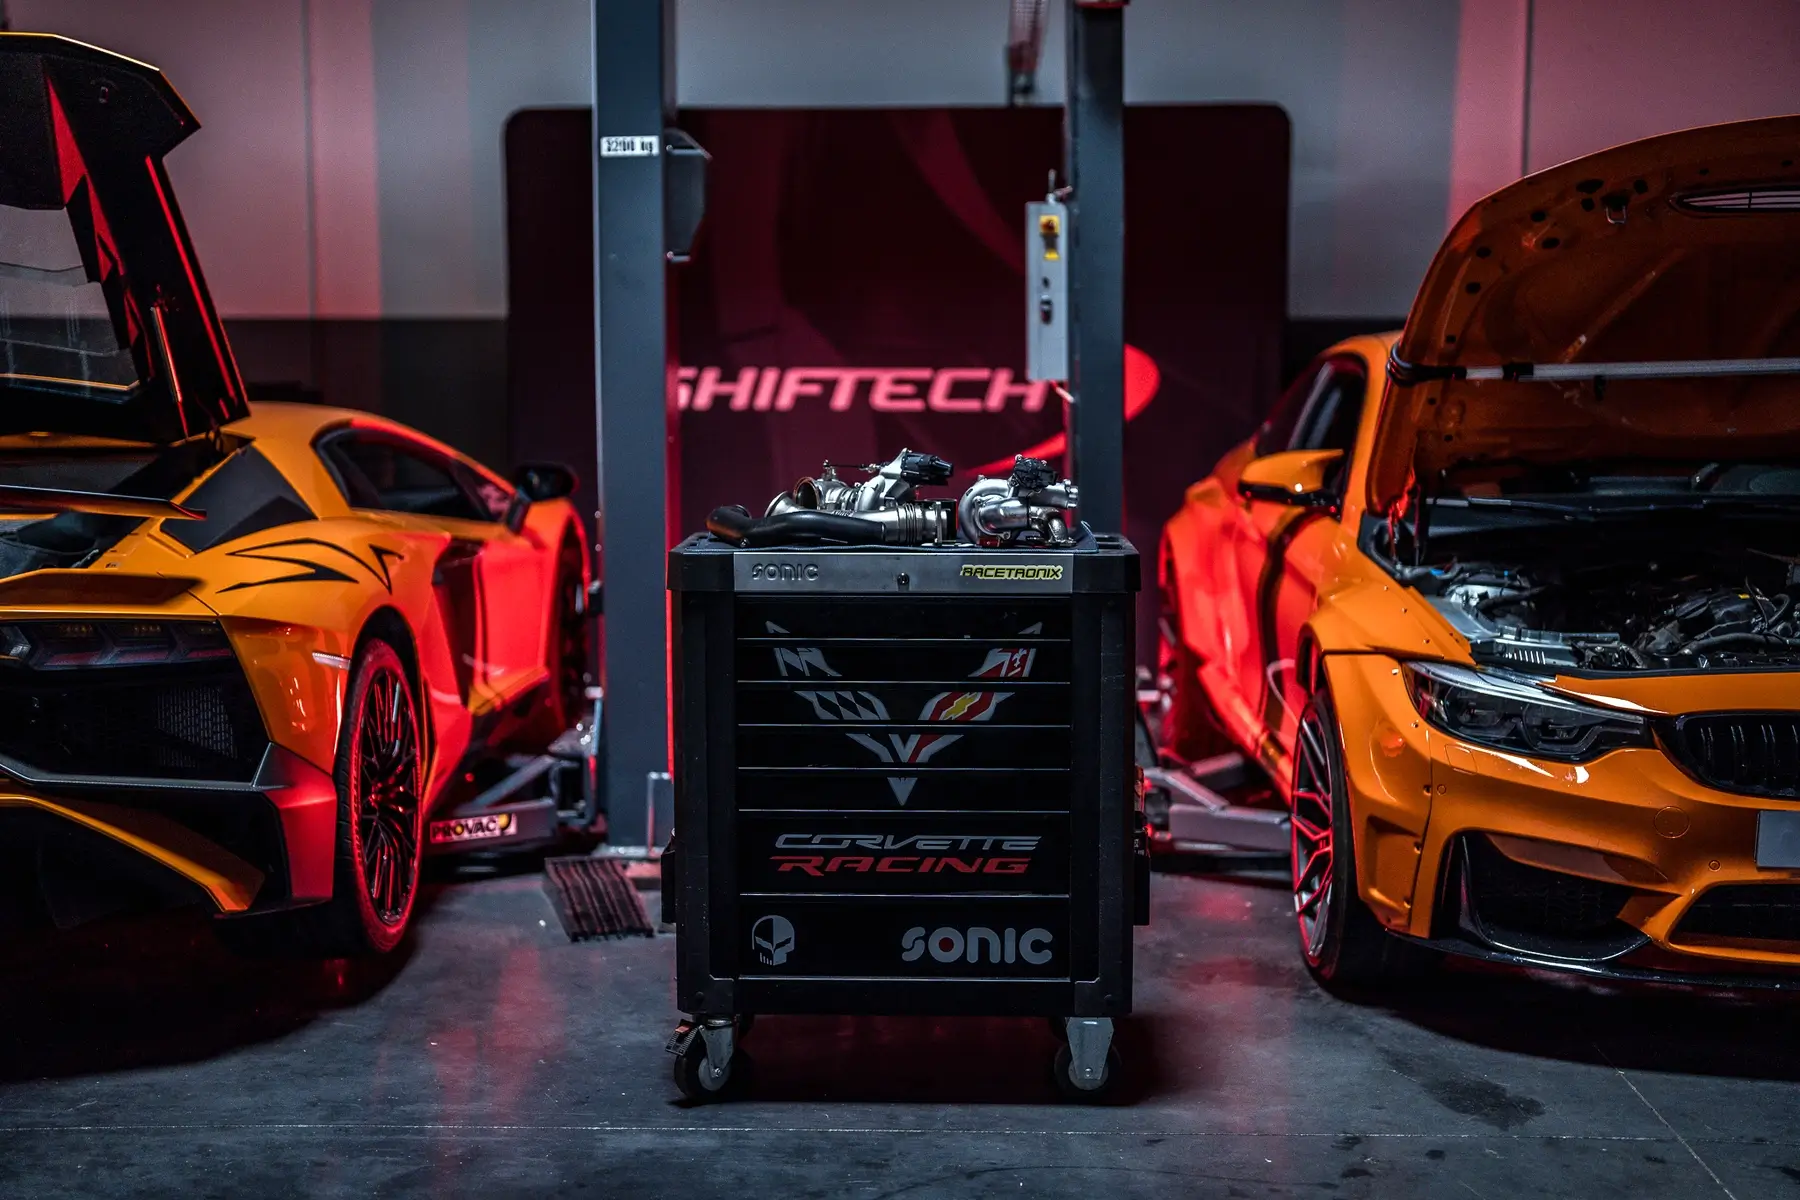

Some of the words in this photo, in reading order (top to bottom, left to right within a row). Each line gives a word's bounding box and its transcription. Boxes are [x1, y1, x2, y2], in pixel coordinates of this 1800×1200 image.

[752, 563, 819, 581] SONIC
[961, 566, 1062, 579] RACETRONIX
[775, 834, 1042, 850] CORVETTE
[769, 855, 1031, 876] RACING
[901, 926, 1053, 965] SONIC
